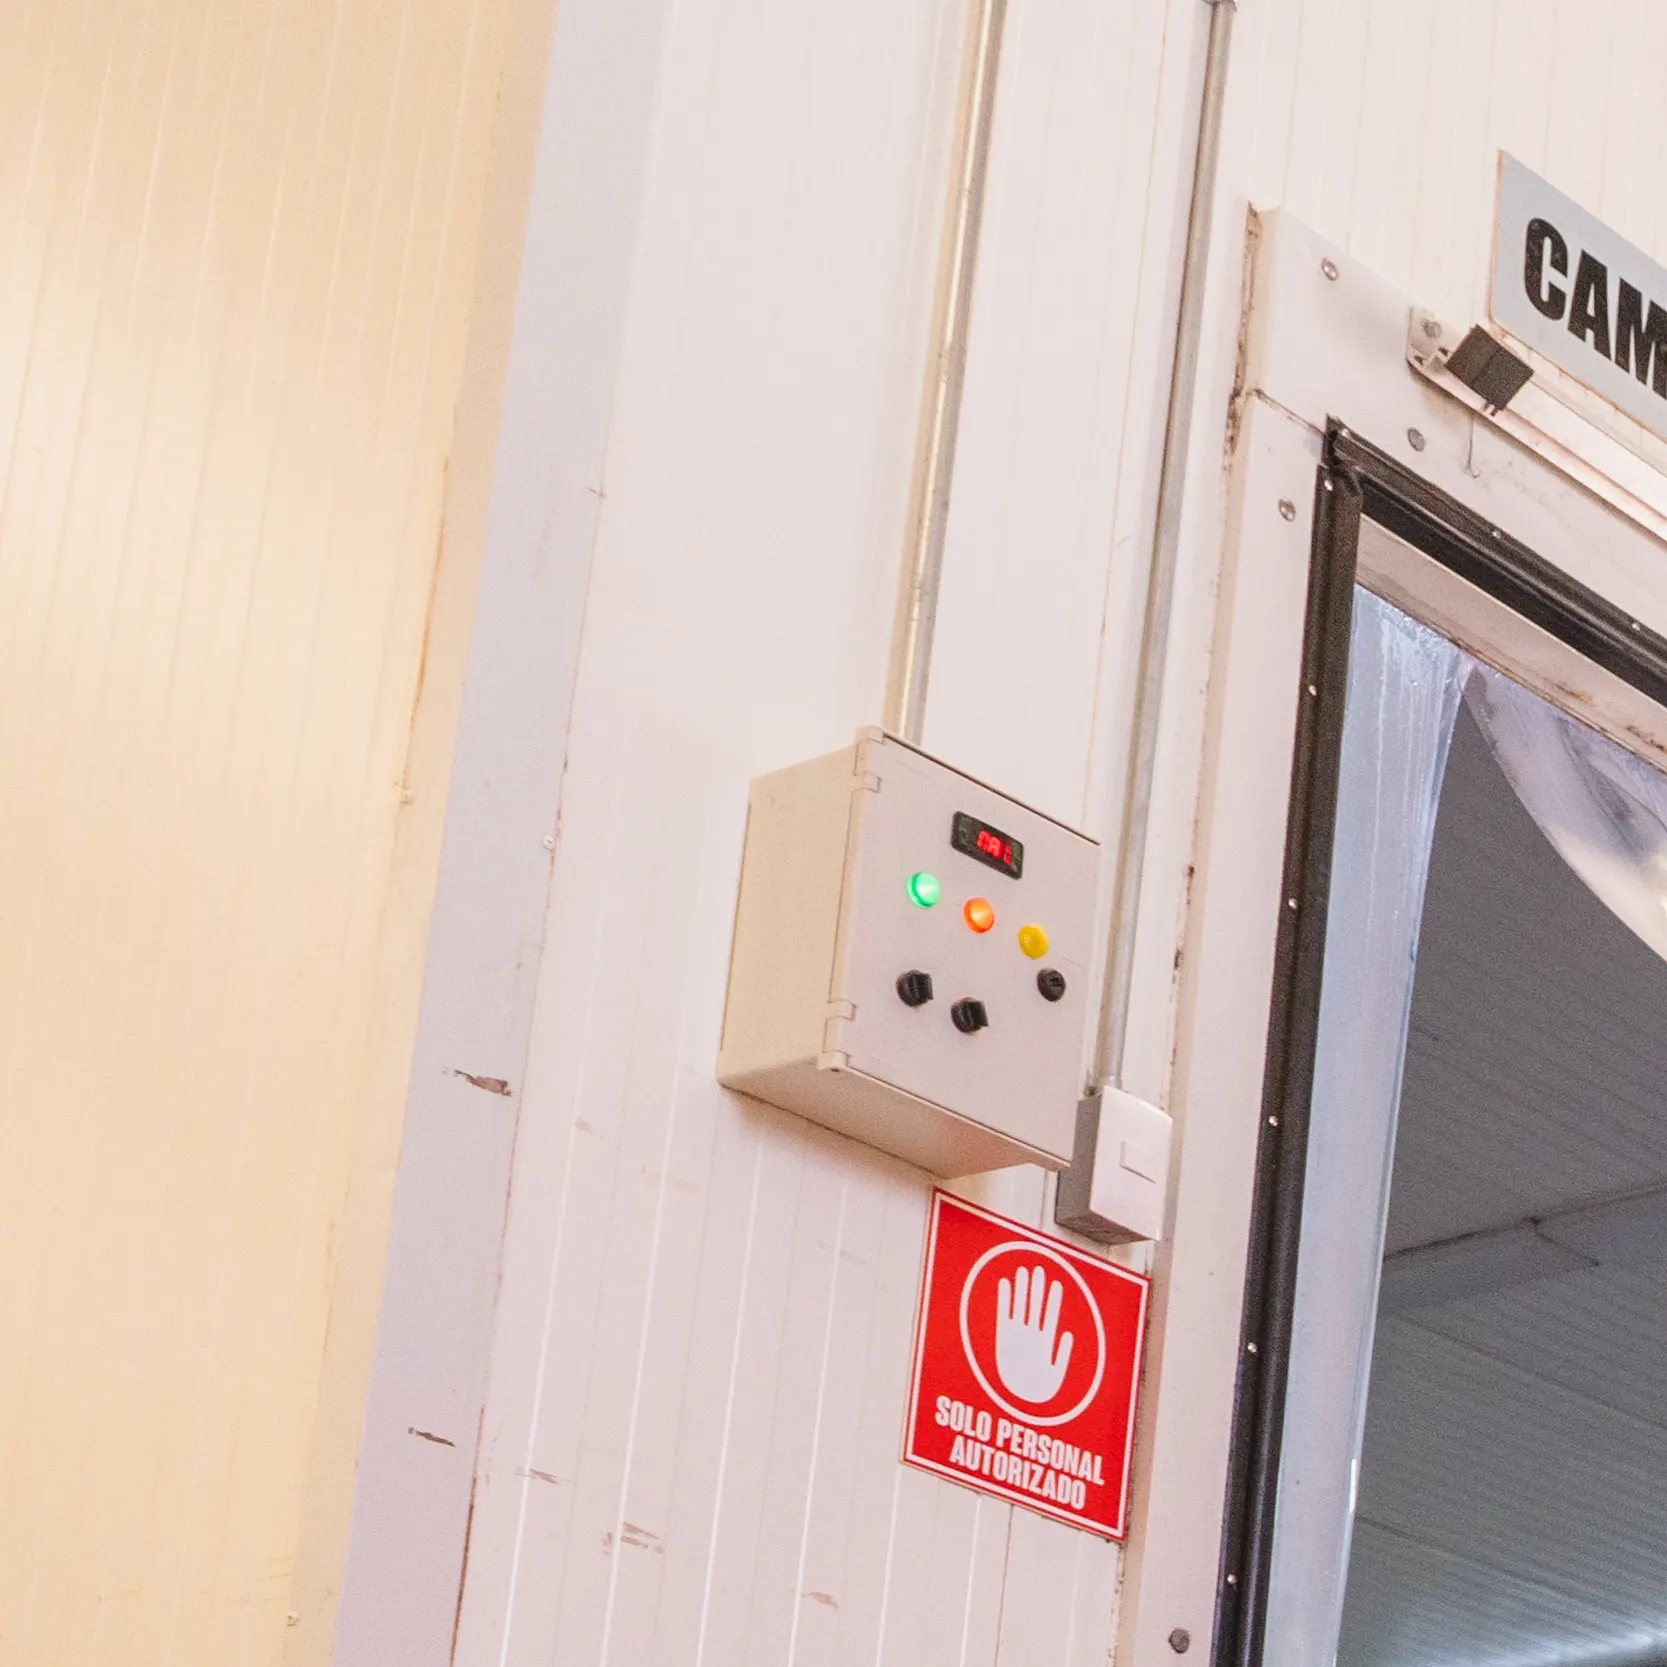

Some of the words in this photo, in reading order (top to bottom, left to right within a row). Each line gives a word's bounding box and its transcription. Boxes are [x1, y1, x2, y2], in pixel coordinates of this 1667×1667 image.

[935, 1395, 992, 1442] SOLO
[996, 1418, 1105, 1486] PERSONAL
[949, 1435, 1087, 1510] AUTORIZADO
